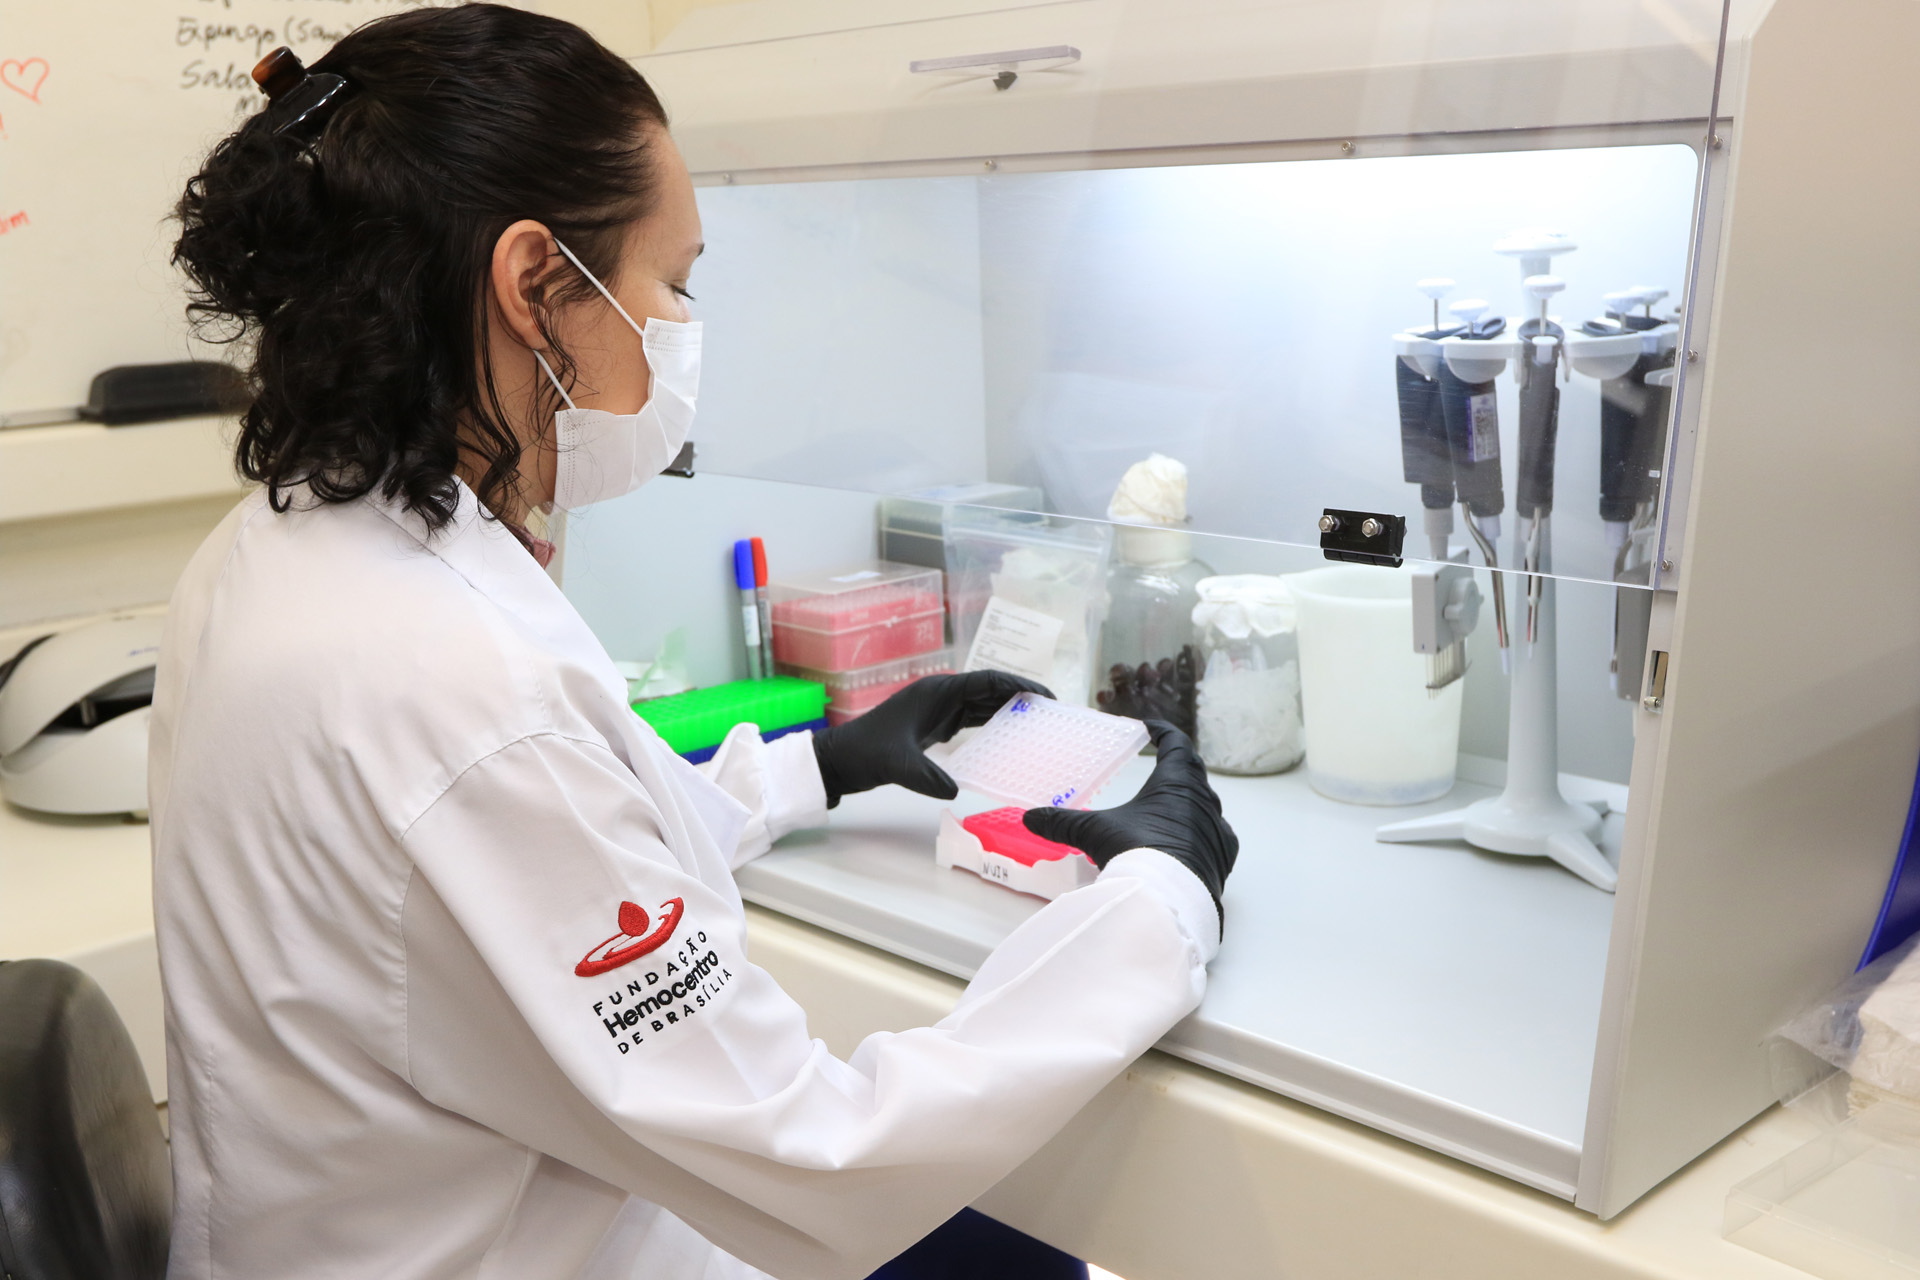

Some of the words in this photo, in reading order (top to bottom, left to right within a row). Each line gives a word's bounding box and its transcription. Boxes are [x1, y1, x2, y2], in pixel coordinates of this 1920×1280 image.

[593, 931, 707, 1016] FUNDAÇÃO
[602, 950, 719, 1038] Hemocentro
[617, 1032, 644, 1055] DE
[651, 969, 732, 1032] BRASÍLIA
